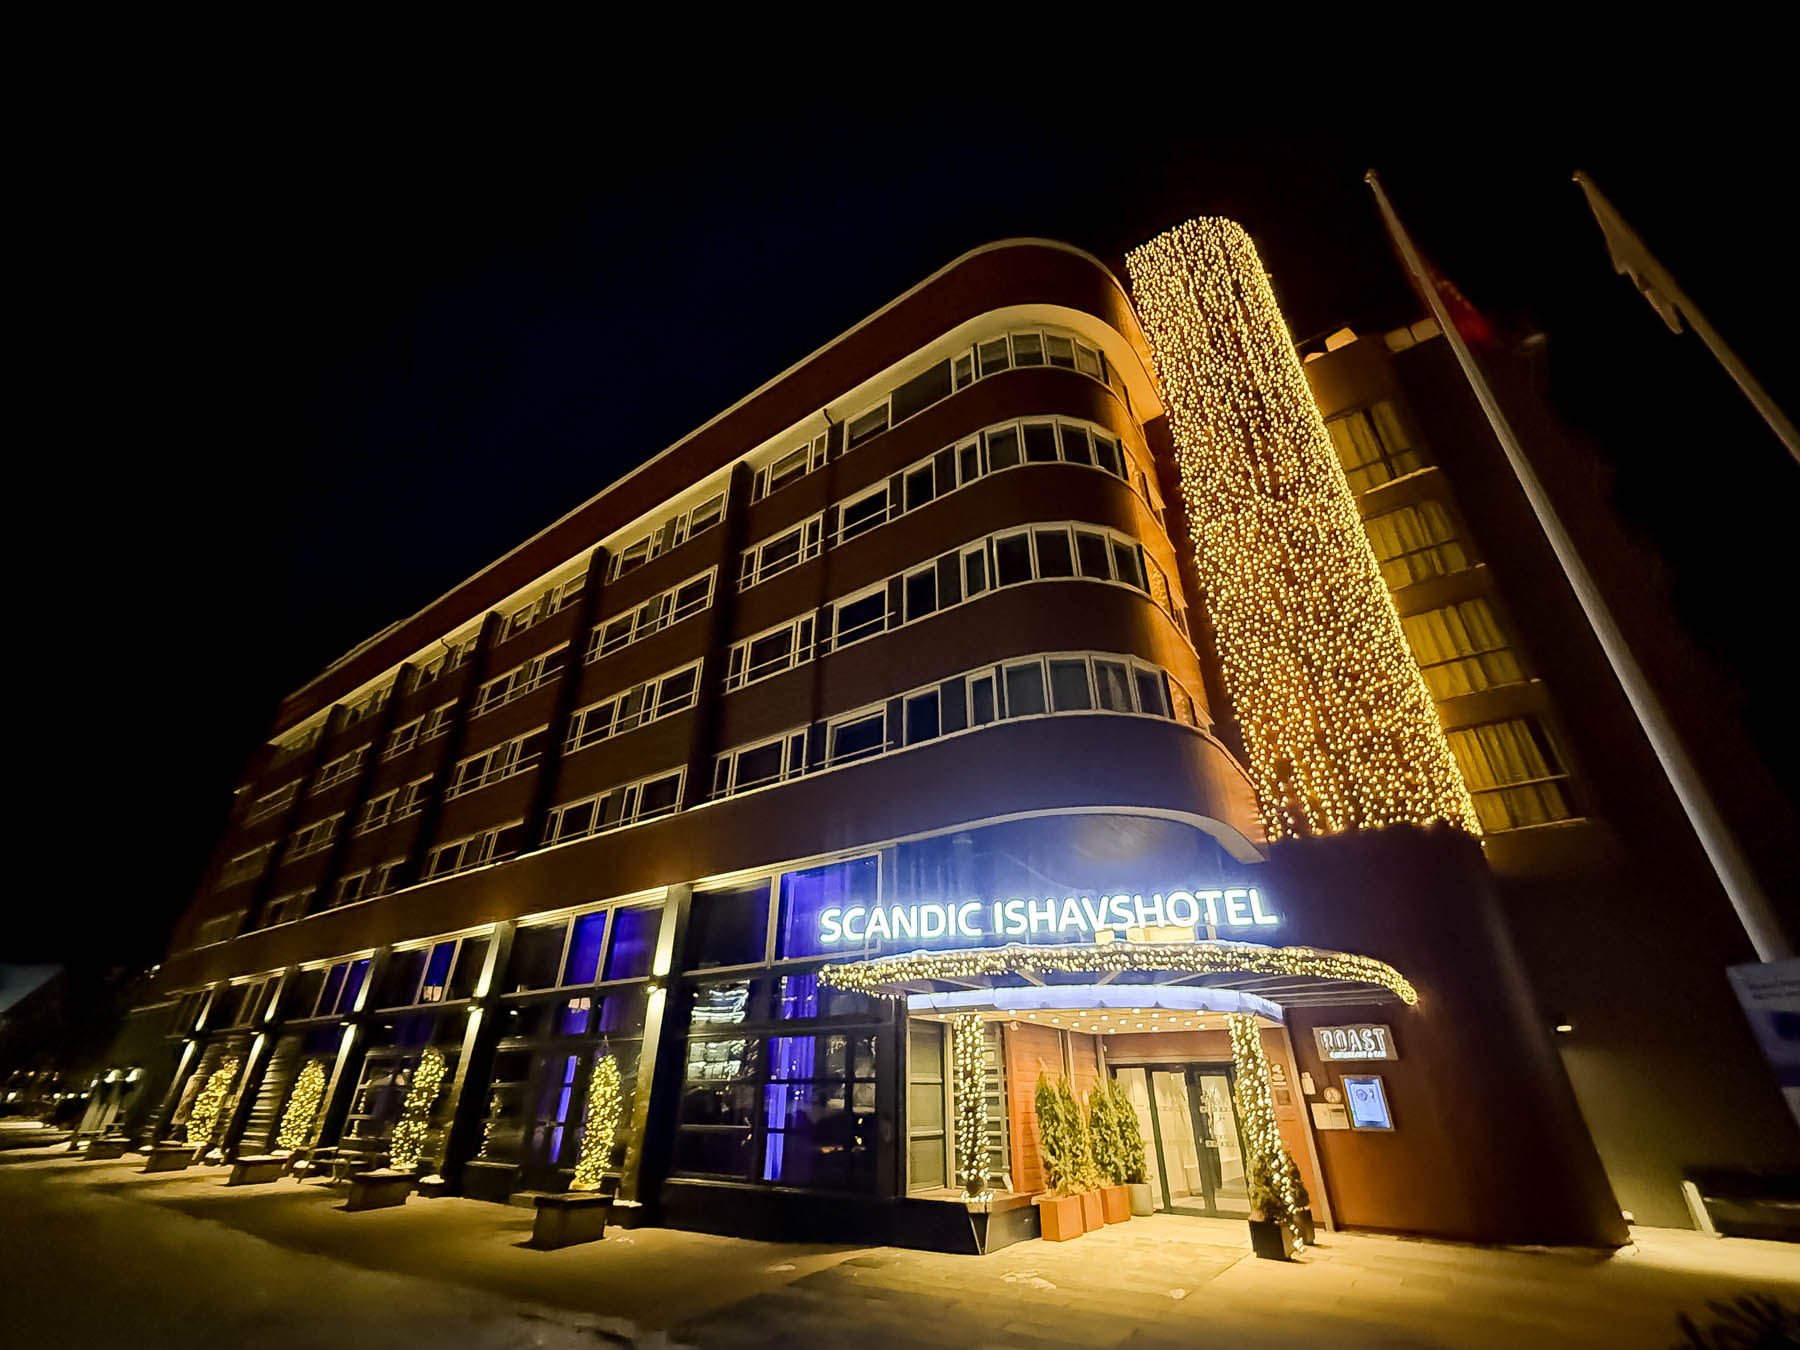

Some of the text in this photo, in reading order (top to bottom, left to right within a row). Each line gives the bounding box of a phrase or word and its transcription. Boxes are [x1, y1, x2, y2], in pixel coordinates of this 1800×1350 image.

[819, 888, 1280, 943] SCANDIC ISHAVSHOTEL
[1319, 1028, 1387, 1052] ROAST
